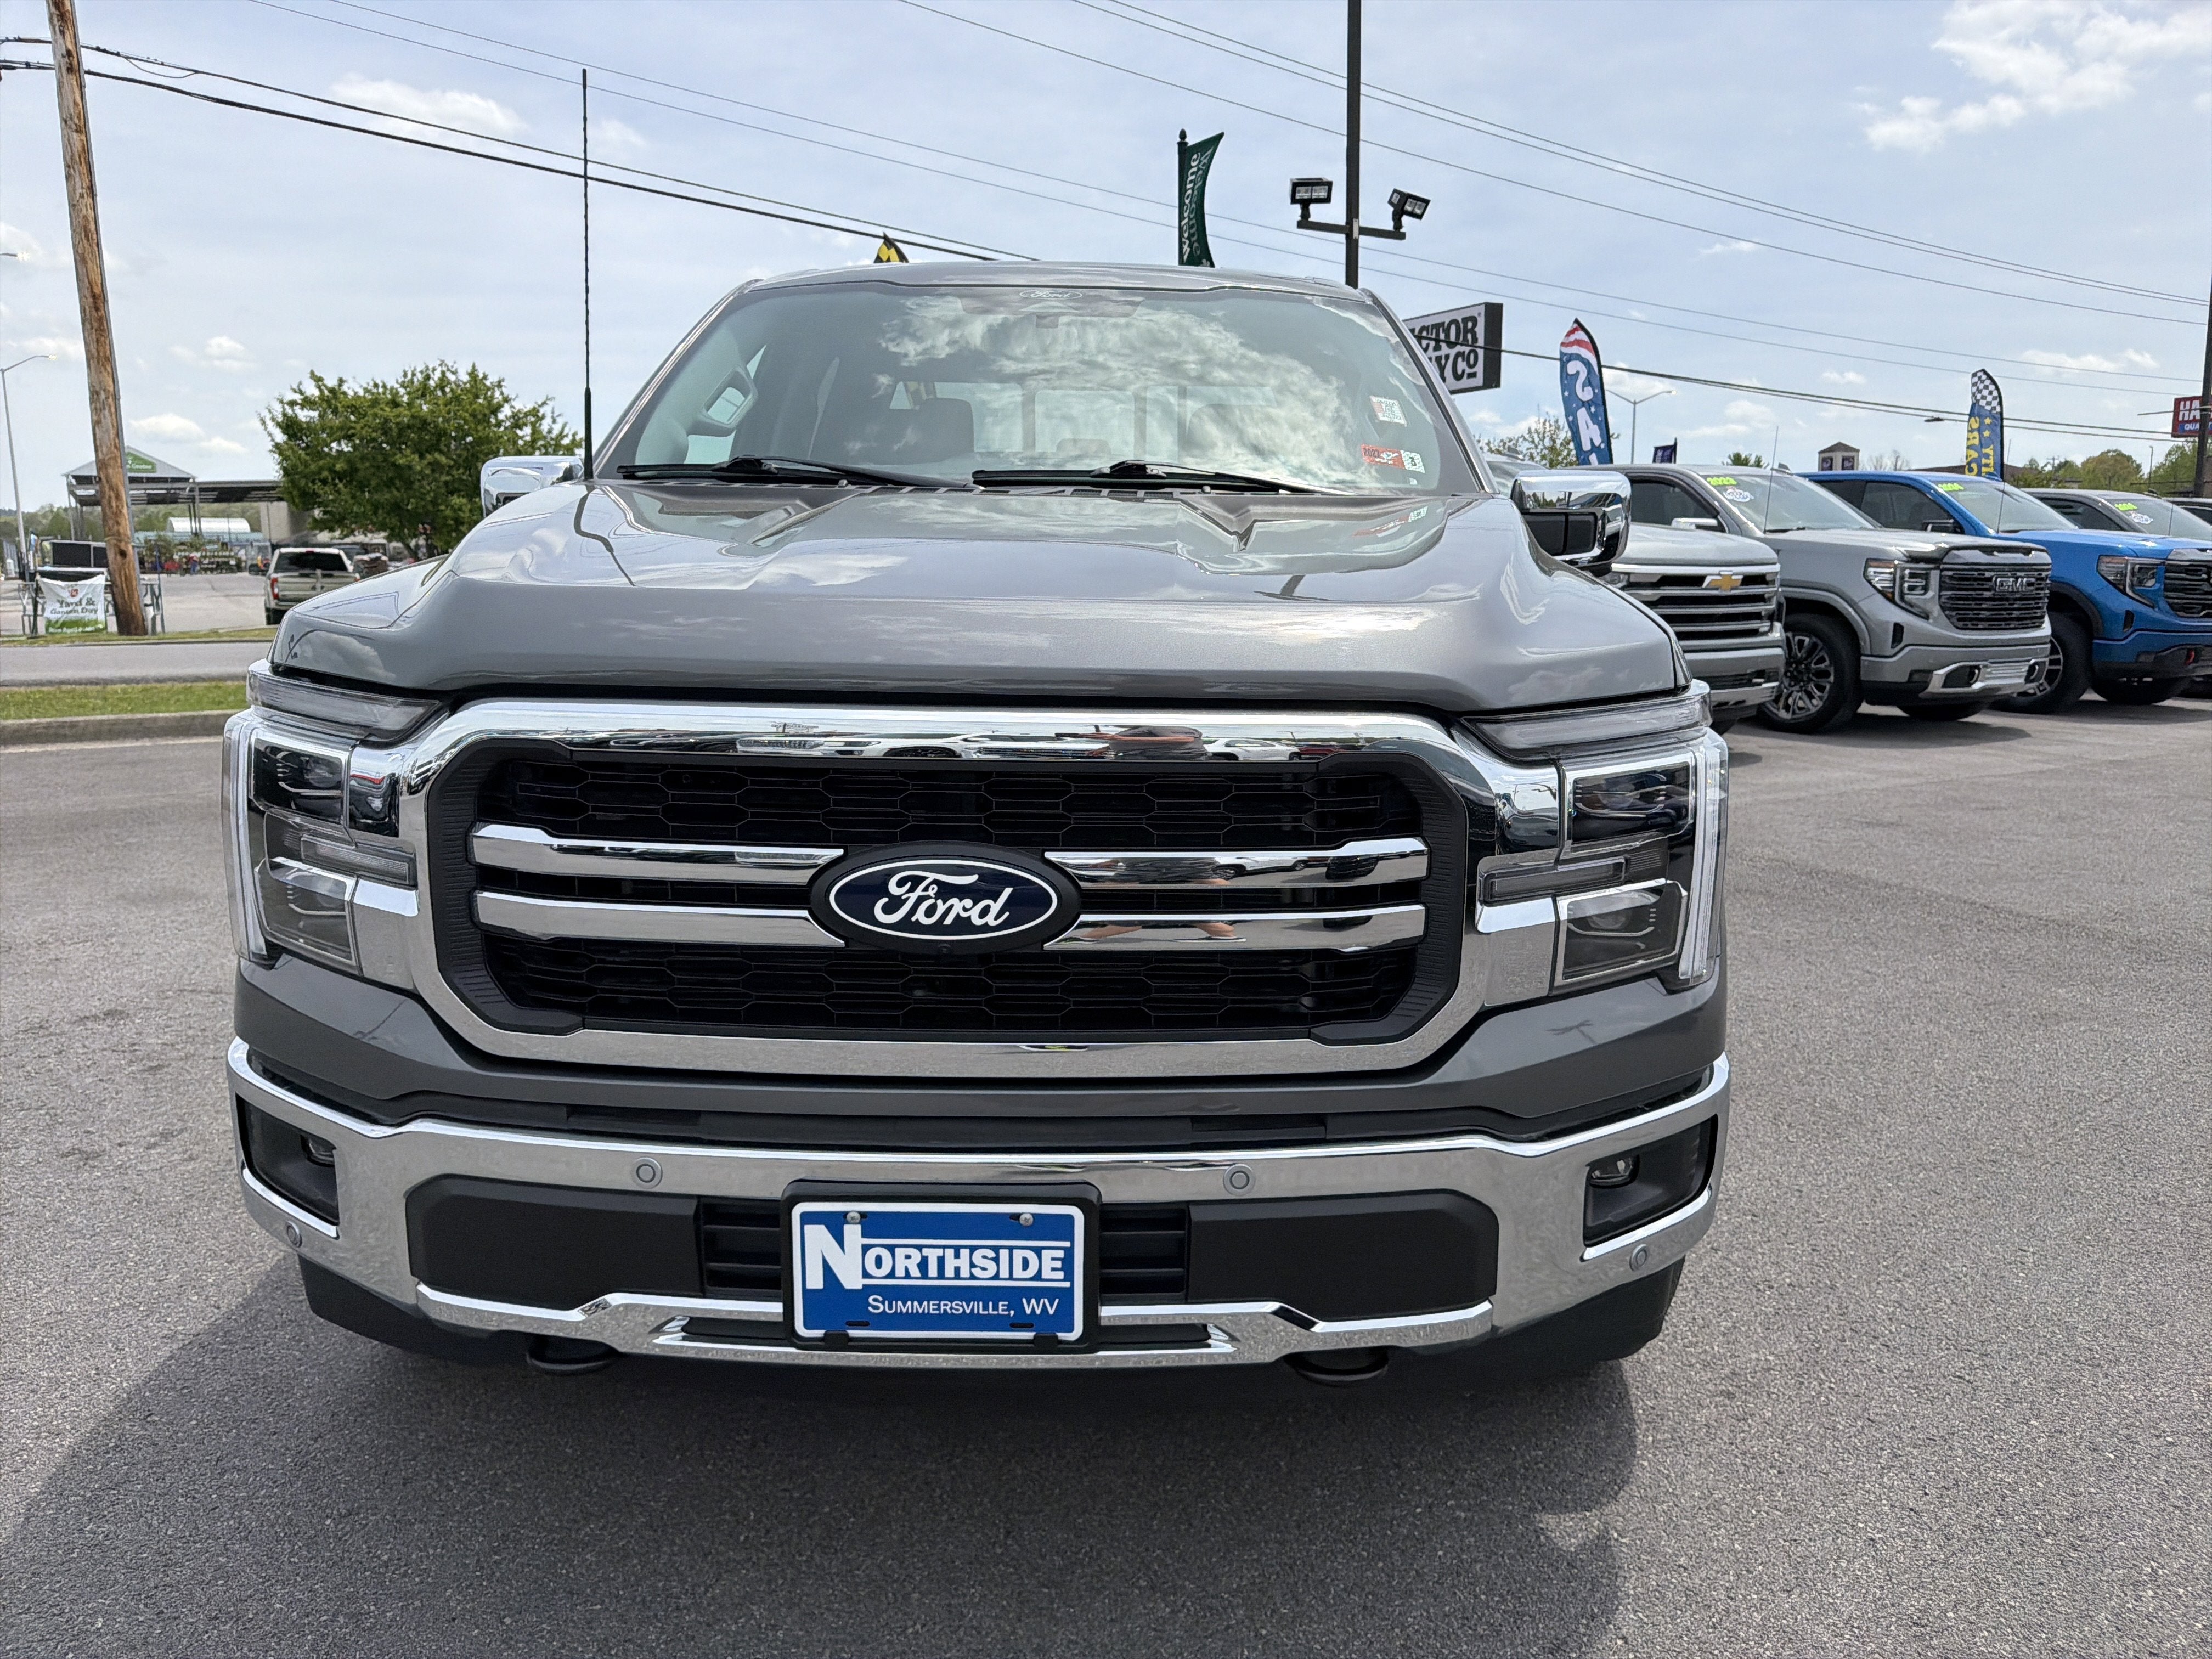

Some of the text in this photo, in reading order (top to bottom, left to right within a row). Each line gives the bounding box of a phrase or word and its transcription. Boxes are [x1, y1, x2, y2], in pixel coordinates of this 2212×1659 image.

[1996, 578, 2036, 591] GMC
[874, 871, 1014, 926] Ford
[804, 1224, 1065, 1290] NORTHSIDE
[1022, 1298, 1059, 1315] WV
